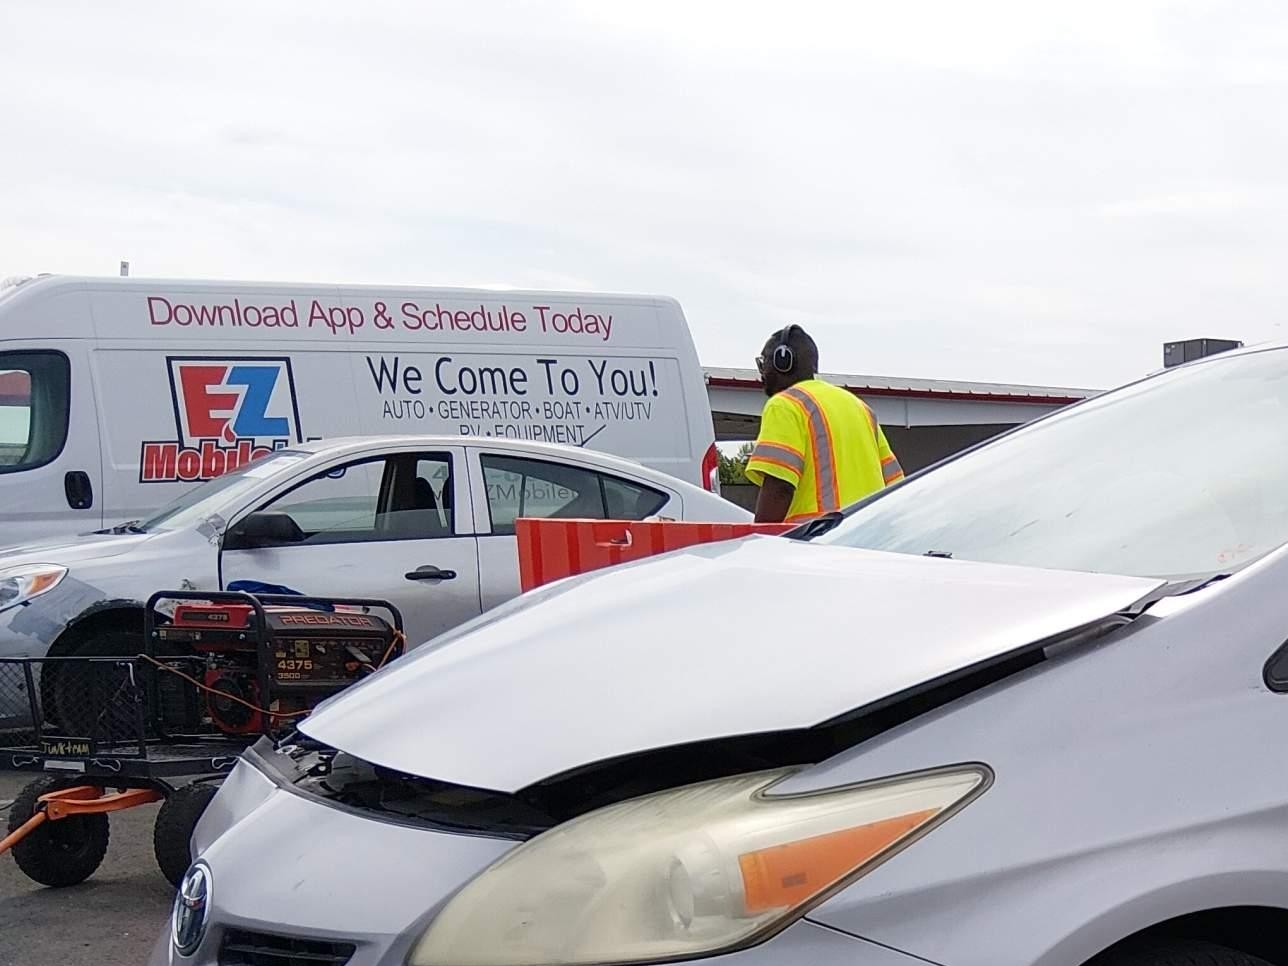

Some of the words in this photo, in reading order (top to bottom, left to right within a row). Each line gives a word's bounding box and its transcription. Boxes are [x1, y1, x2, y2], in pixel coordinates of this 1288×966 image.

[147, 296, 299, 327] Download
[308, 299, 365, 335] App
[373, 301, 395, 329] &
[401, 302, 527, 332] Schedule
[533, 306, 613, 341] Today
[366, 356, 422, 394] We
[435, 356, 528, 395] Come
[536, 358, 579, 396] To
[588, 359, 658, 397] You!
[179, 366, 290, 437] EZ
[383, 400, 425, 419] AUTO
[438, 400, 533, 420] GENERATOR
[543, 401, 581, 420] BOAT
[279, 614, 375, 627] PREDATOR
[277, 660, 313, 670] 4375
